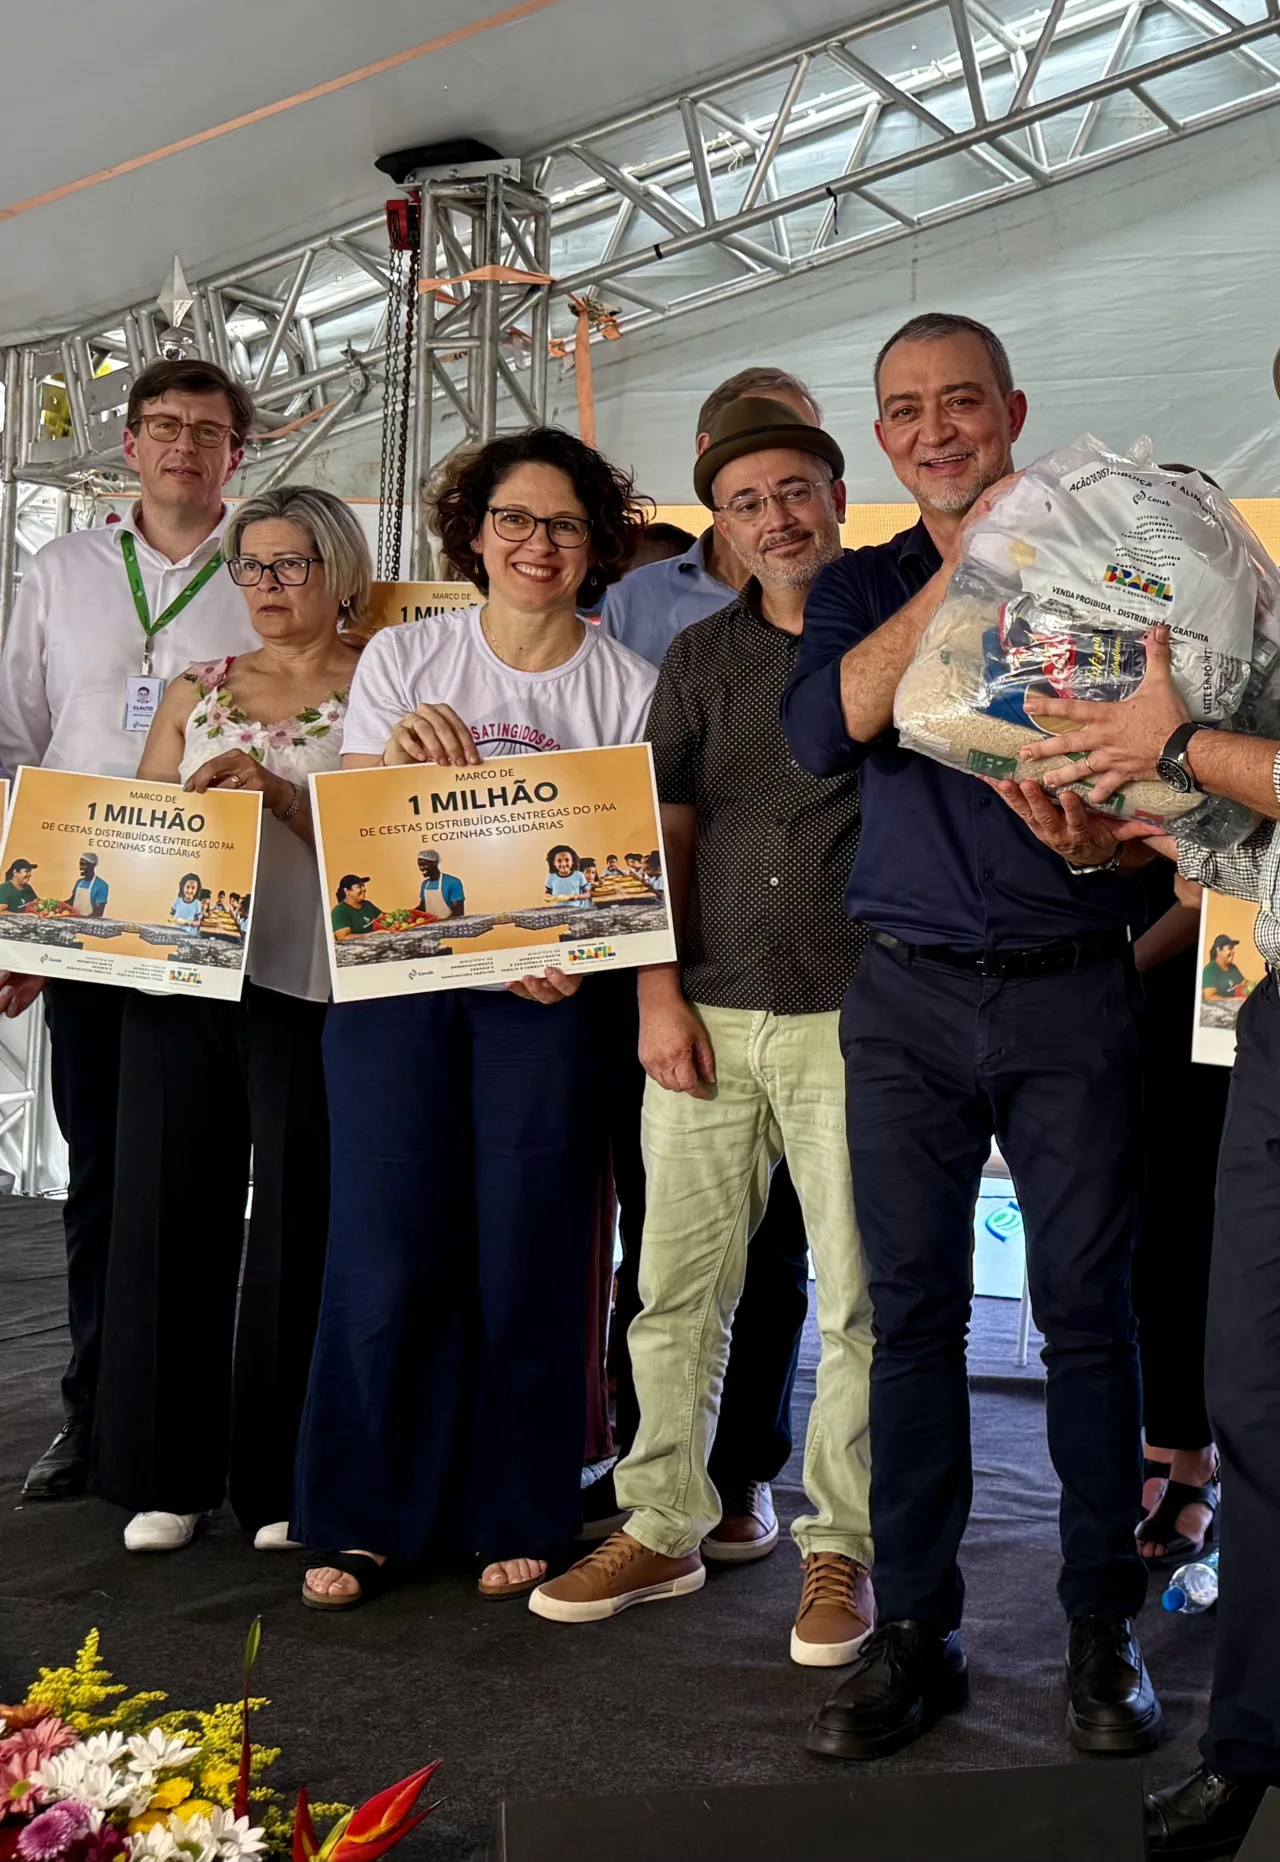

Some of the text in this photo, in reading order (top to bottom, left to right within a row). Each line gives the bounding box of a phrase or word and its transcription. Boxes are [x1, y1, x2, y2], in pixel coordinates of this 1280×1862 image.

[1069, 477, 1091, 491] AÇÃO
[1147, 496, 1170, 506] Conab
[1103, 565, 1173, 602] BRASIL
[401, 606, 407, 622] 1
[1052, 586, 1075, 600] VENDA
[1076, 593, 1111, 612] PROIBIDA
[1172, 626, 1208, 642] GRATUITA
[456, 769, 515, 781] MARCO DE
[129, 791, 177, 803] MARCO DE
[408, 779, 558, 815] 1 MILHÃO
[88, 802, 205, 833] 1 MILHÃO
[360, 827, 376, 837] DE
[379, 823, 422, 835] CESTAS
[573, 805, 590, 815] DO
[594, 803, 616, 812] PAA
[42, 822, 54, 831] DE
[58, 823, 92, 835] CESTAS
[208, 841, 220, 849] DO
[221, 841, 235, 850] PAA
[422, 820, 563, 843] E COZINHAS SOLIDÁRIAS
[97, 839, 145, 852] COZINHAS
[148, 845, 200, 858] SOLIDÁRIAS
[568, 945, 616, 962] BRASIL
